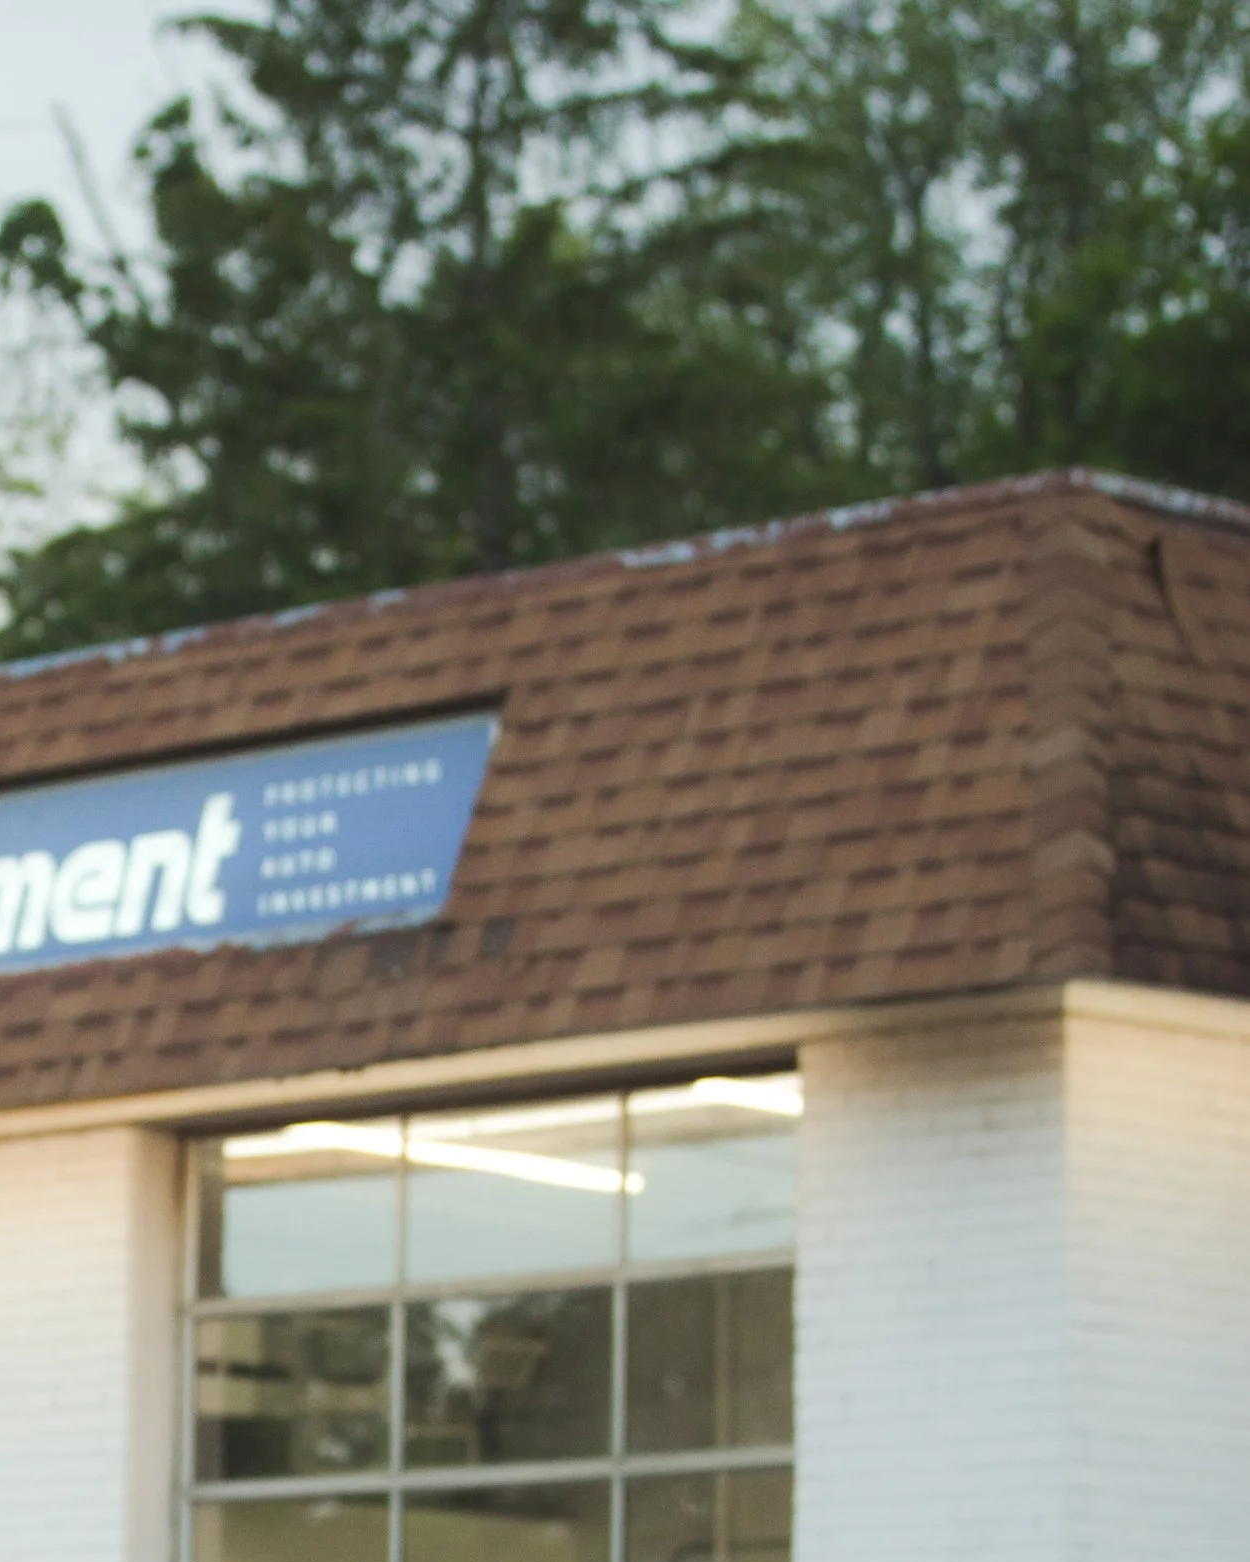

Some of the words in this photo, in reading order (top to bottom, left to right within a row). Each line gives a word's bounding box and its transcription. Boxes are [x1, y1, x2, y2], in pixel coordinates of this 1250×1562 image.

[263, 757, 443, 808] PROTECTING
[263, 810, 338, 844] YOUR
[260, 846, 338, 880] AUTO
[256, 868, 437, 918] INVESTMENT
